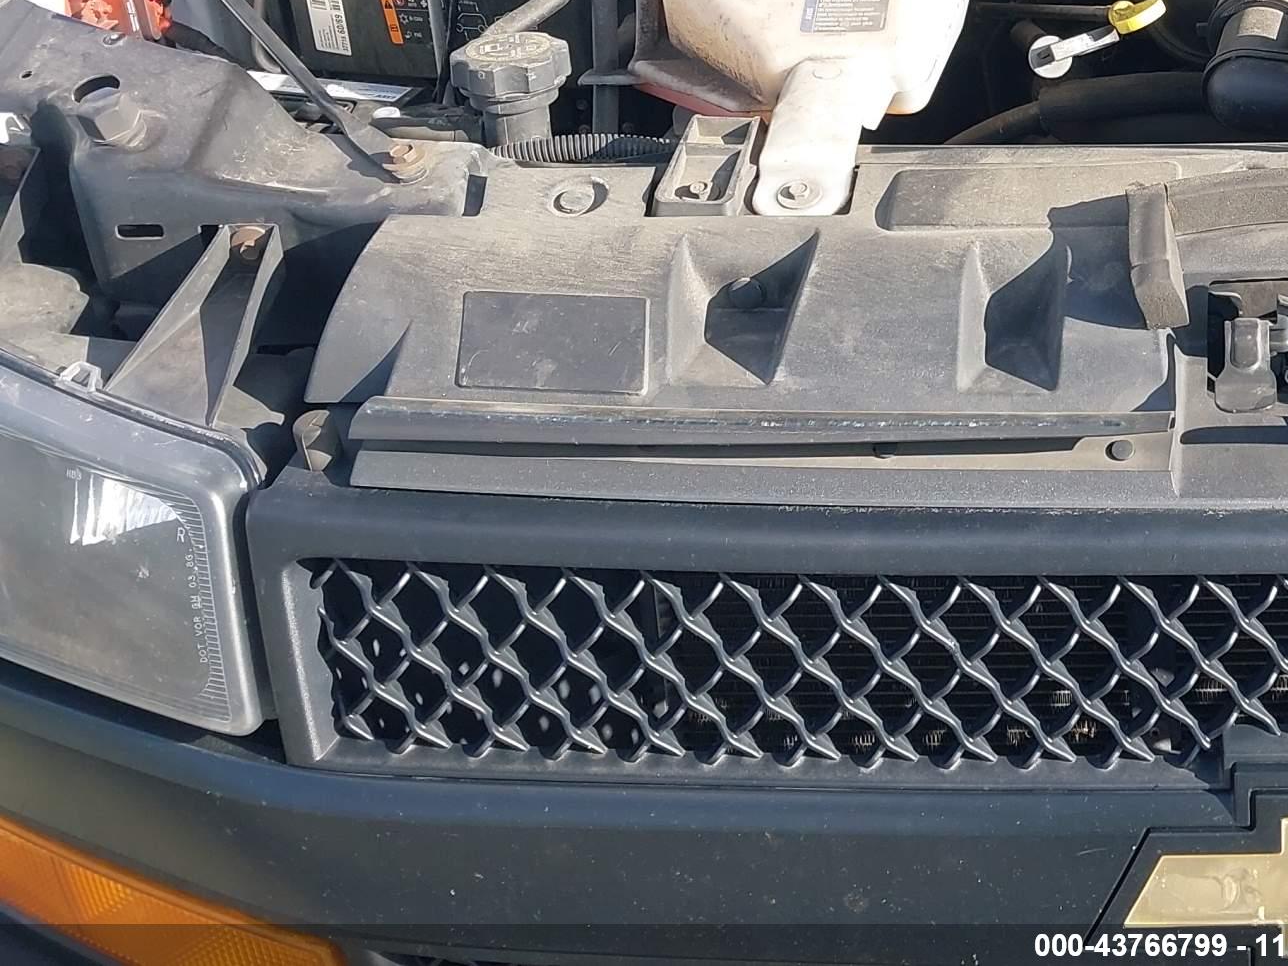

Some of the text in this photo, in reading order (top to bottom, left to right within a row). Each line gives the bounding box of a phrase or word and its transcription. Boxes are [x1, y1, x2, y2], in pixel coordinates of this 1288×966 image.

[176, 527, 187, 543] R
[193, 616, 204, 637] VOR
[197, 643, 208, 663] DOT
